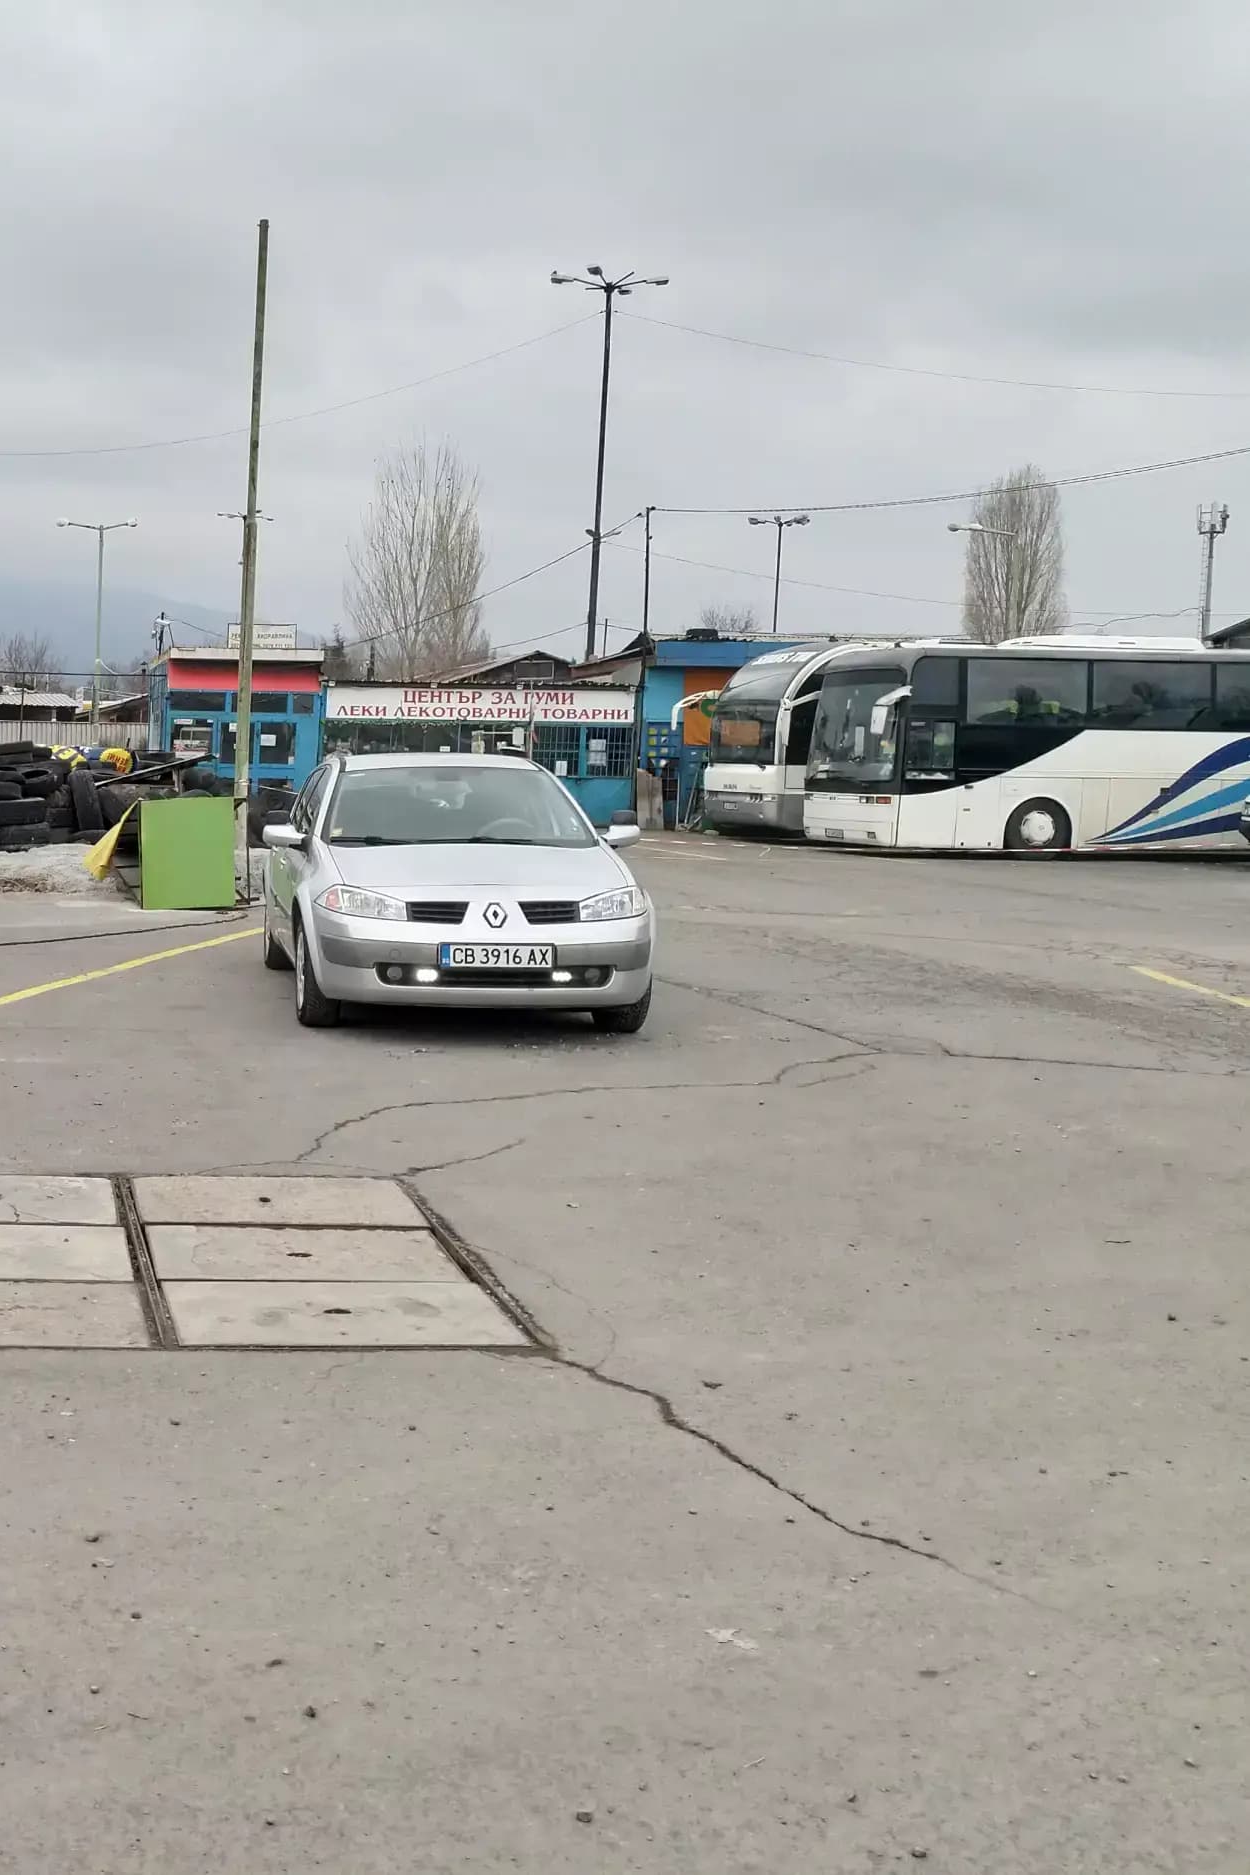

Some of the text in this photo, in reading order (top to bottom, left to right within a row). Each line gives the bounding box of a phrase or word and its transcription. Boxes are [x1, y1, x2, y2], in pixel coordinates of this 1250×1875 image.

[403, 690, 575, 705] ЦЕНТЪР ЗА ГУМИ
[337, 705, 630, 720] ЛЕКИ ЛЕКОТОВАРНИ ТОВАРНИ
[479, 948, 522, 965] 3916
